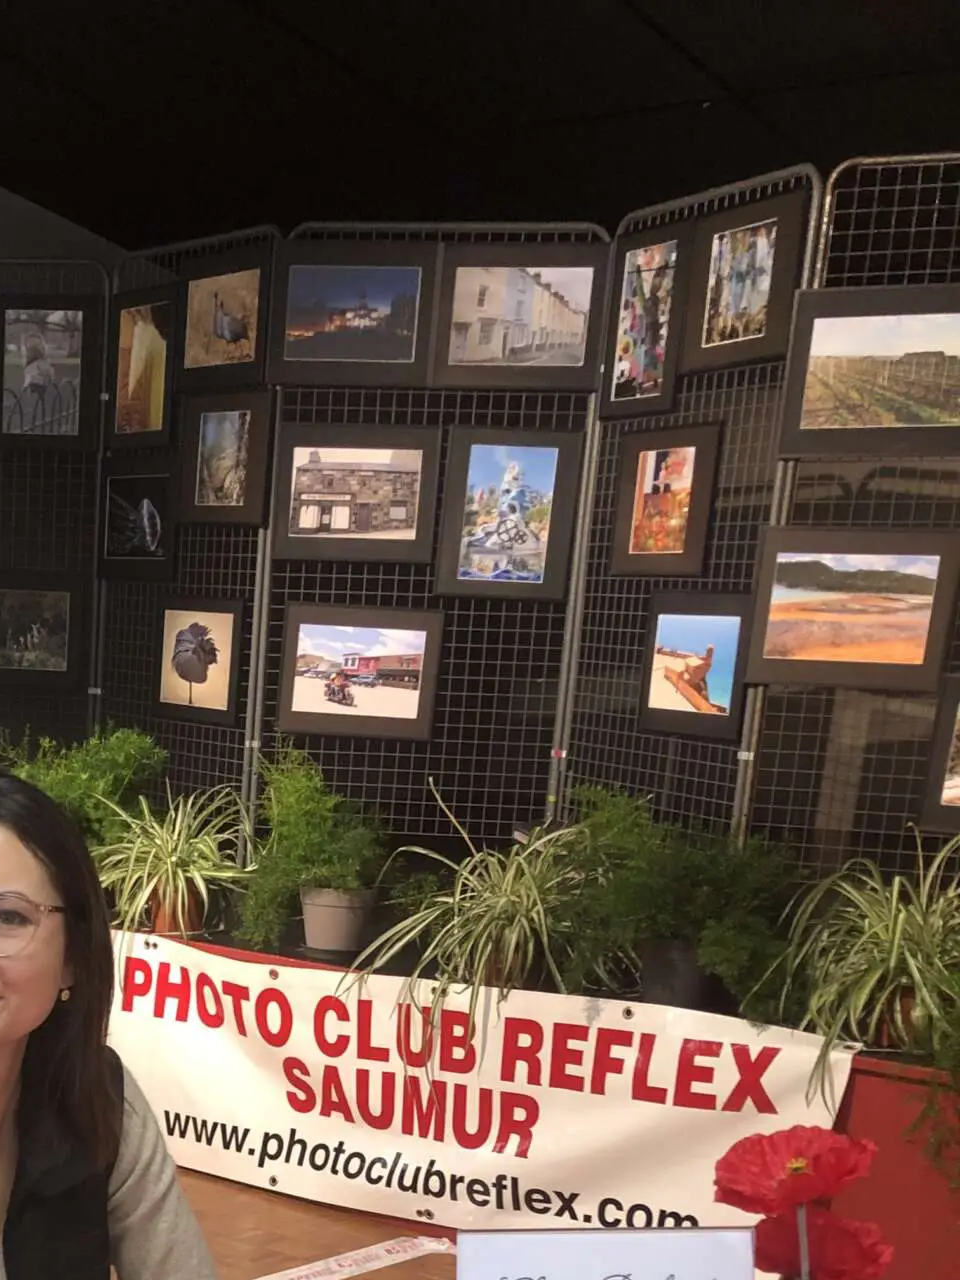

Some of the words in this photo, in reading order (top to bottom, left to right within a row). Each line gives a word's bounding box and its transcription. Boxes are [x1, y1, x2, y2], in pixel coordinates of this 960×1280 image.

[121, 955, 293, 1048] PHOTO
[314, 995, 478, 1074] CLUB
[500, 1016, 781, 1115] REFLEX
[282, 1056, 541, 1159] SAUMUR
[164, 1109, 700, 1228] www.photoclubreflex.com
